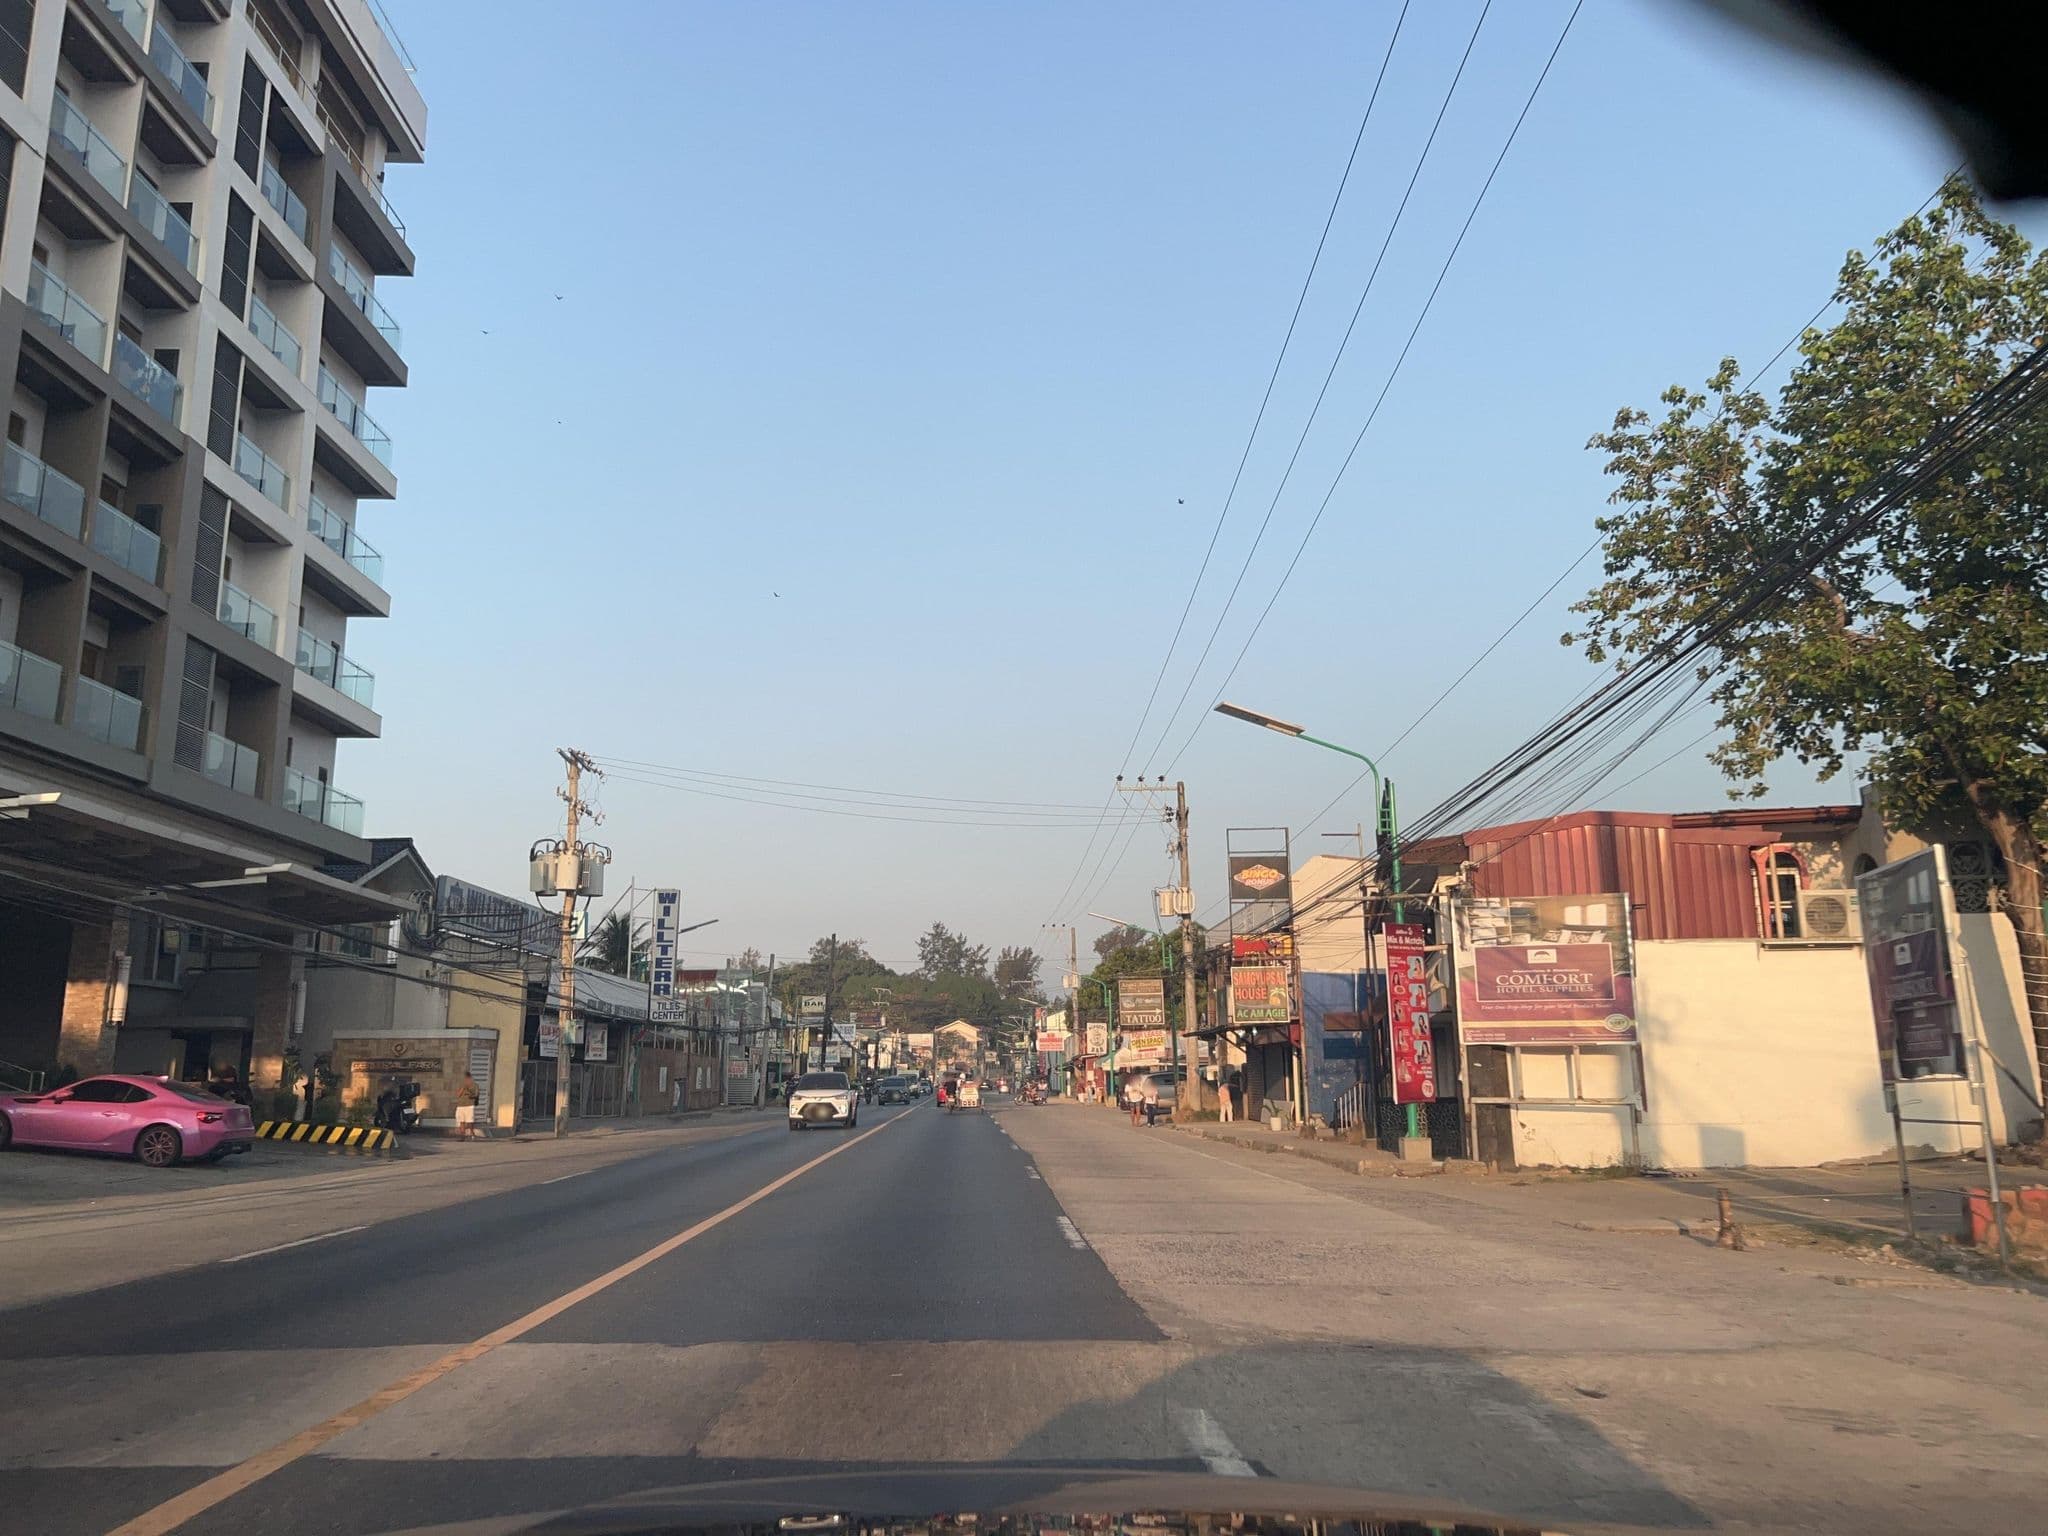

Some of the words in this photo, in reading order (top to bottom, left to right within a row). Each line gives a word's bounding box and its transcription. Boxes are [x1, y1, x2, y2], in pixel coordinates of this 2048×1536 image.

[1241, 869, 1278, 879] BINGO
[1233, 971, 1286, 985] SAMGYUPSAL
[1496, 973, 1593, 986] COMFORT
[1235, 988, 1268, 1000] HOUSE
[1497, 986, 1537, 994] HOTEL
[1539, 984, 1593, 993] SUPPLIES
[656, 1002, 681, 1010] TILES
[652, 1011, 684, 1020] CENTER
[1126, 1014, 1161, 1023] TATTOO
